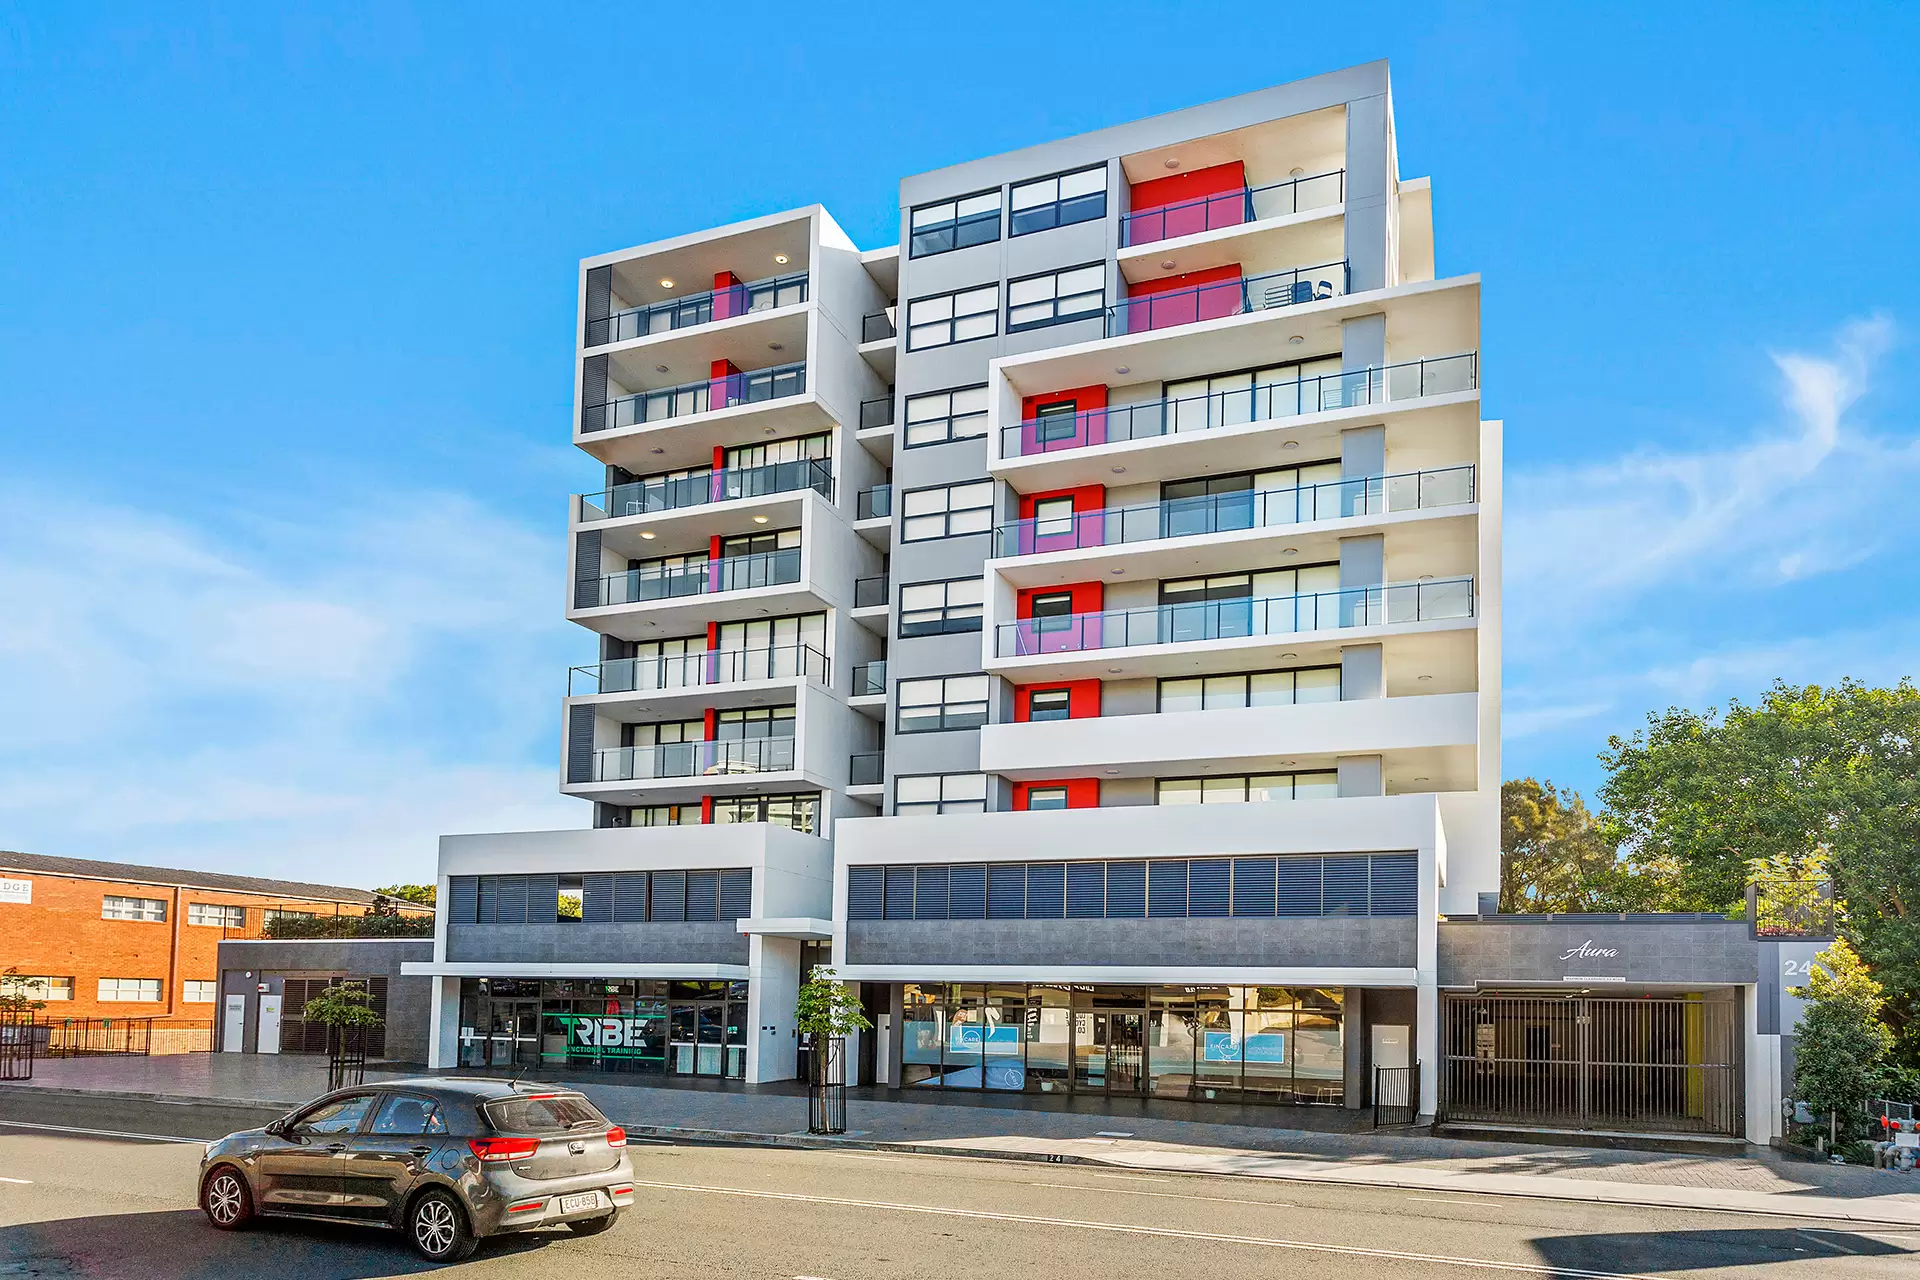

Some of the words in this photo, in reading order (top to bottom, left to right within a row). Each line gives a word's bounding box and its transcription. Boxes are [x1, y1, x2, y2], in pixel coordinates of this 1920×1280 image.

[1559, 939, 1620, 960] Aura
[1784, 959, 1811, 976] 24
[560, 1018, 648, 1047] TRIBE
[1049, 1154, 1061, 1162] 24
